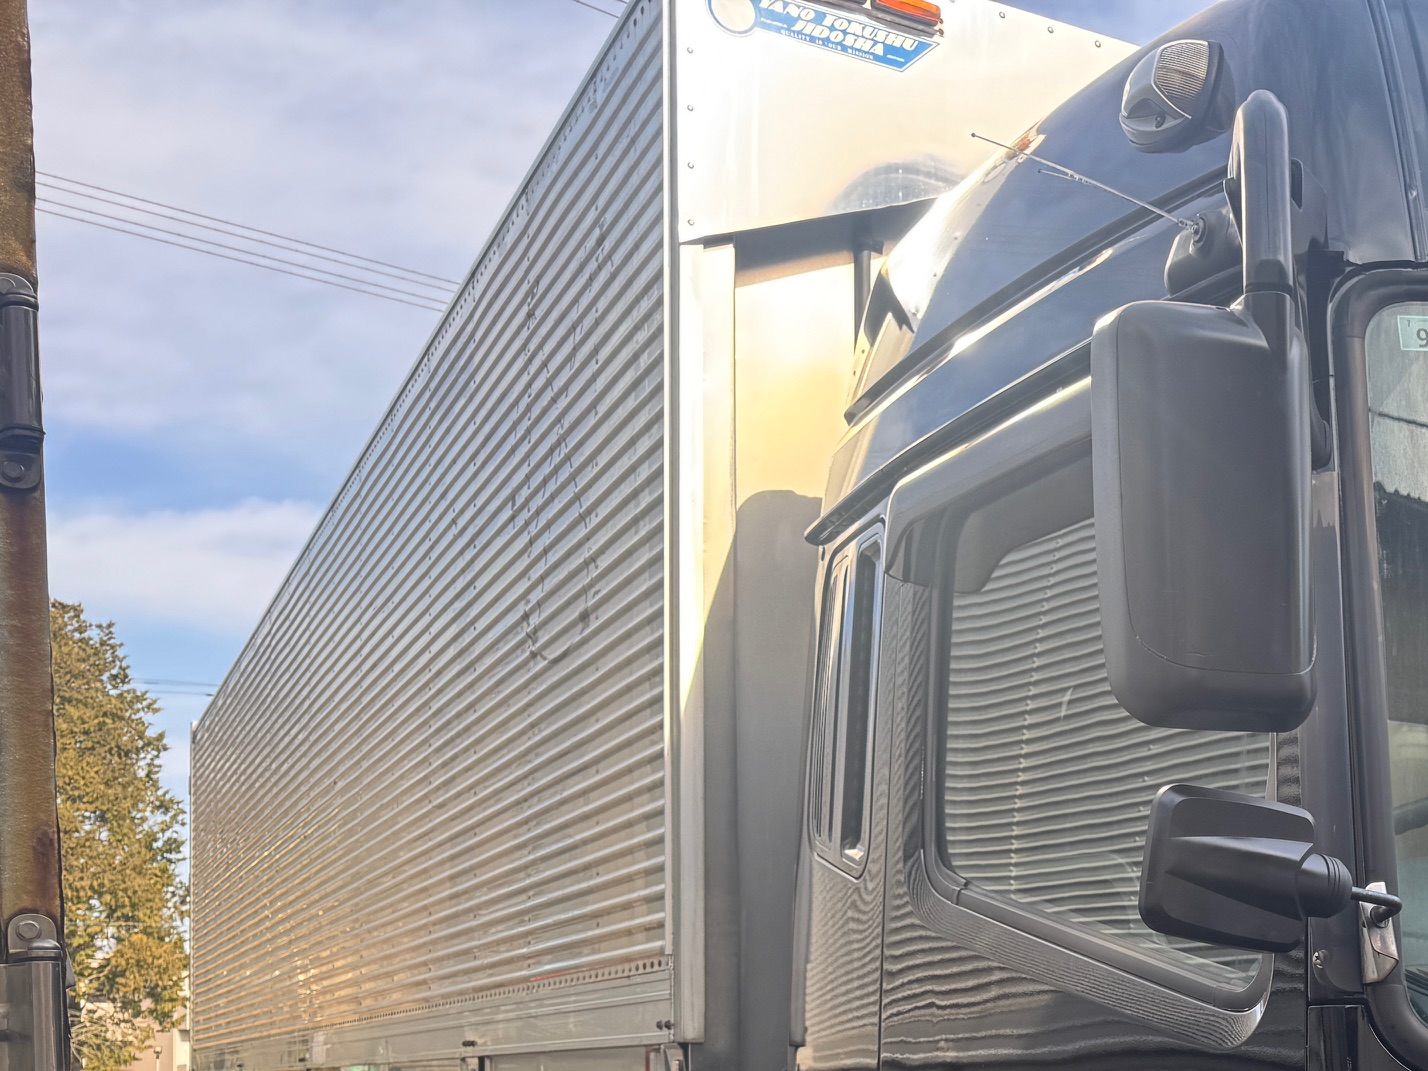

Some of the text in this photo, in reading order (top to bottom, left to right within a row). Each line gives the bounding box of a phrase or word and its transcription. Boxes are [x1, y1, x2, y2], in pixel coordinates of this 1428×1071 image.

[758, 0, 919, 51] YANO TOKUSHU
[791, 19, 885, 56] JIDOSHA
